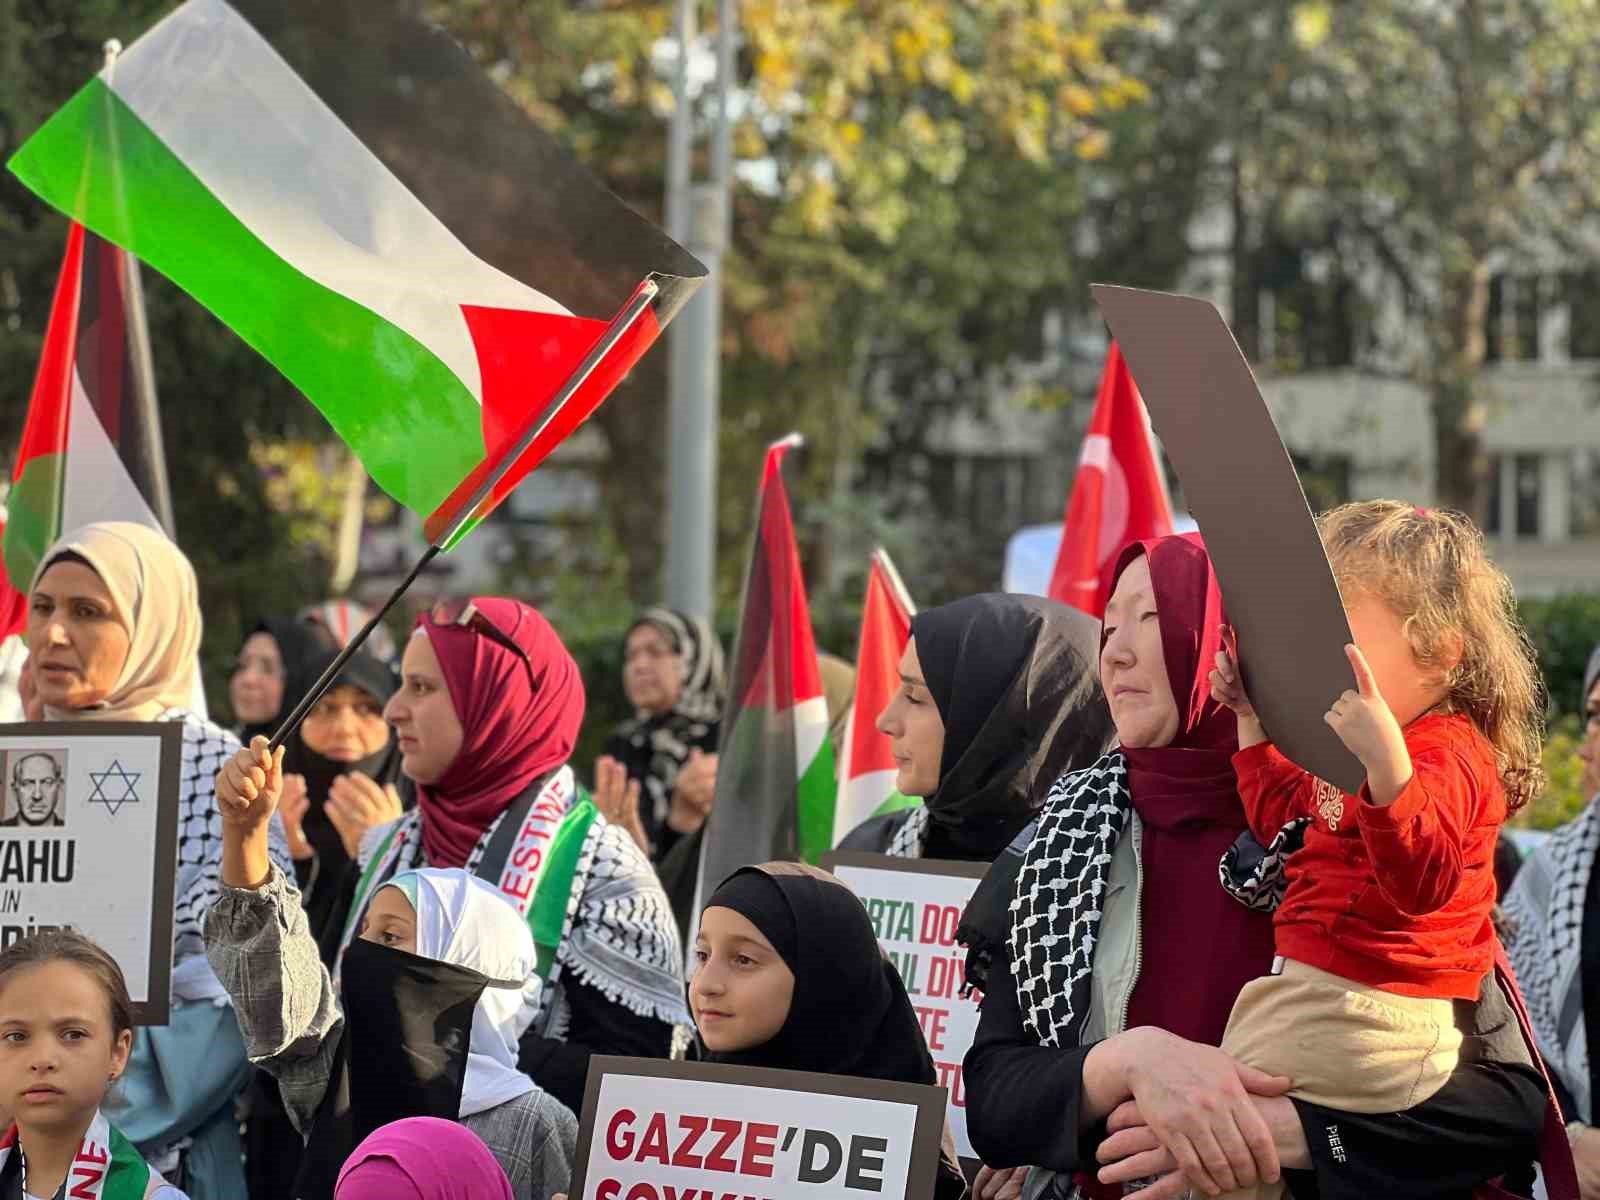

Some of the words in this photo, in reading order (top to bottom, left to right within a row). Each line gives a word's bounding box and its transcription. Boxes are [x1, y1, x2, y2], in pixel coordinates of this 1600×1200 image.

[501, 781, 565, 912] ESTINE
[919, 903, 968, 948] DO
[926, 950, 985, 1002] DİY
[605, 1108, 888, 1192] GAZZE'DE
